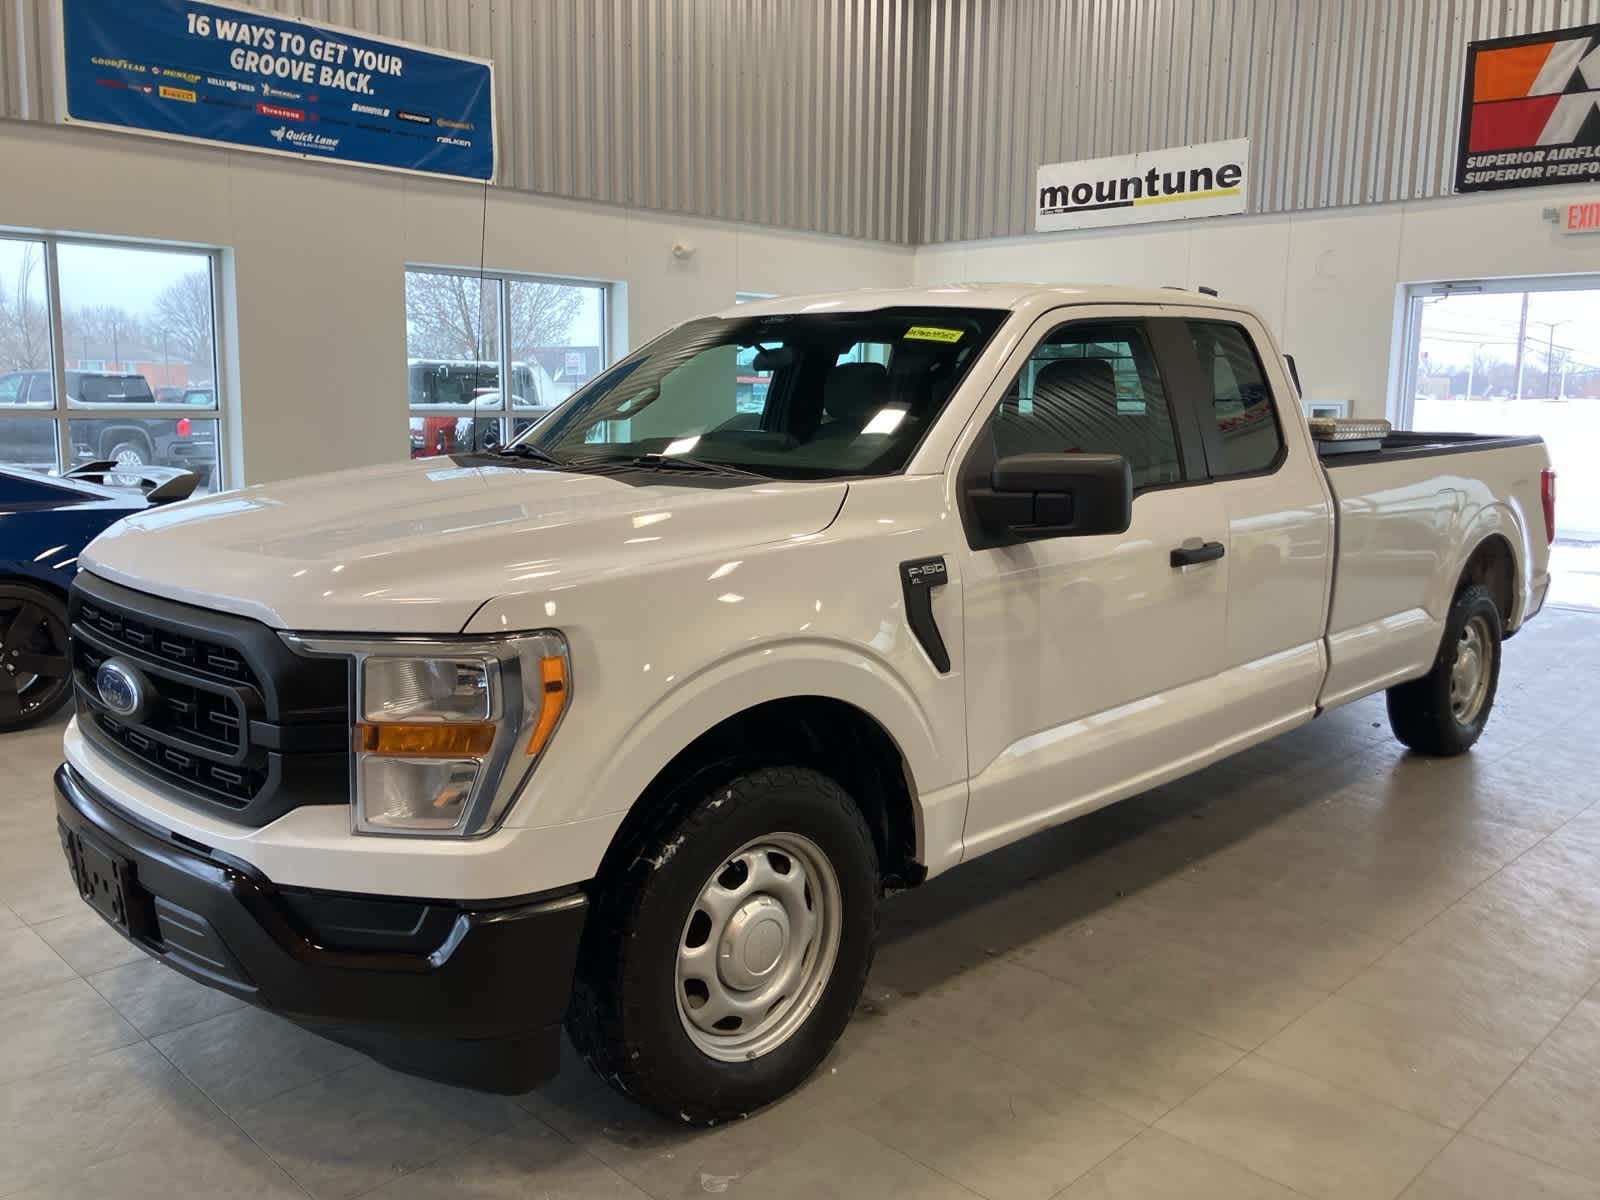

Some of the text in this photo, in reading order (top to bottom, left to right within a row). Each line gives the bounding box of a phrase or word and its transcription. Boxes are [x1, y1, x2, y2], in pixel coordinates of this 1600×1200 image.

[186, 12, 403, 77] 16 WAYS TO GET YOUR
[230, 48, 375, 96] GROOVE BACK.
[286, 130, 314, 143] Quick
[314, 134, 340, 146] Lane
[1466, 150, 1546, 169] SUPERIOR
[1464, 166, 1545, 184] SUPERIOR
[1039, 163, 1242, 209] mountune
[908, 563, 945, 578] F-150
